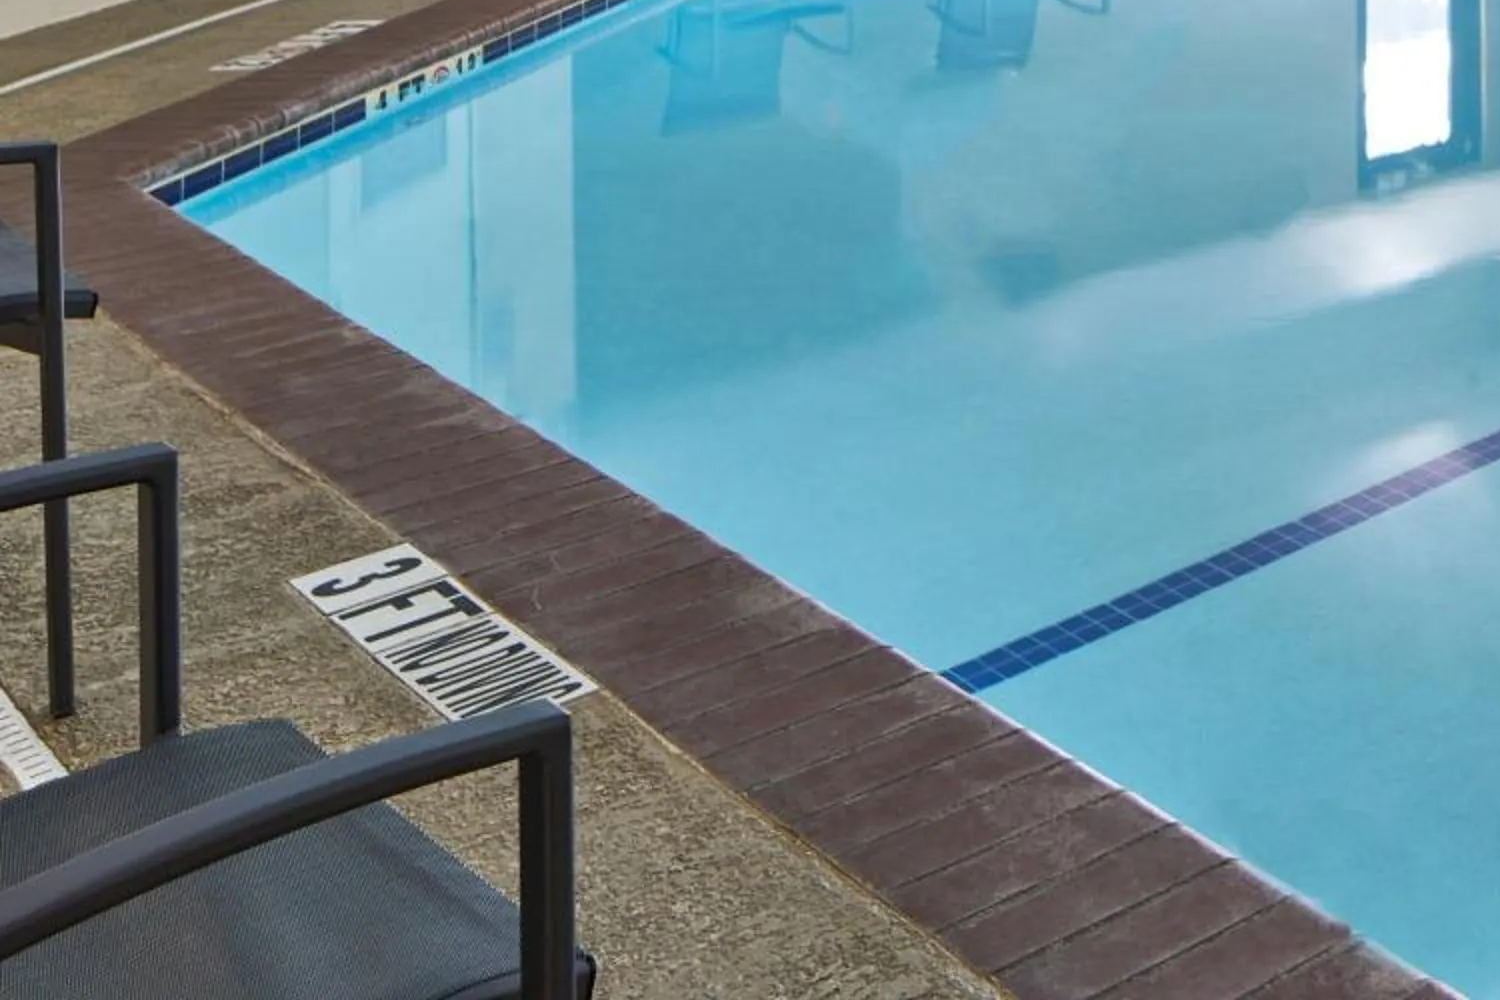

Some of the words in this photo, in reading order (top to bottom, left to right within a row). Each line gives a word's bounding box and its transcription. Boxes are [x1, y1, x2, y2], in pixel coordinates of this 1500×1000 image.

[398, 73, 425, 103] FT
[311, 557, 423, 597] 3
[337, 580, 486, 643] FT
[384, 619, 511, 673] NO
